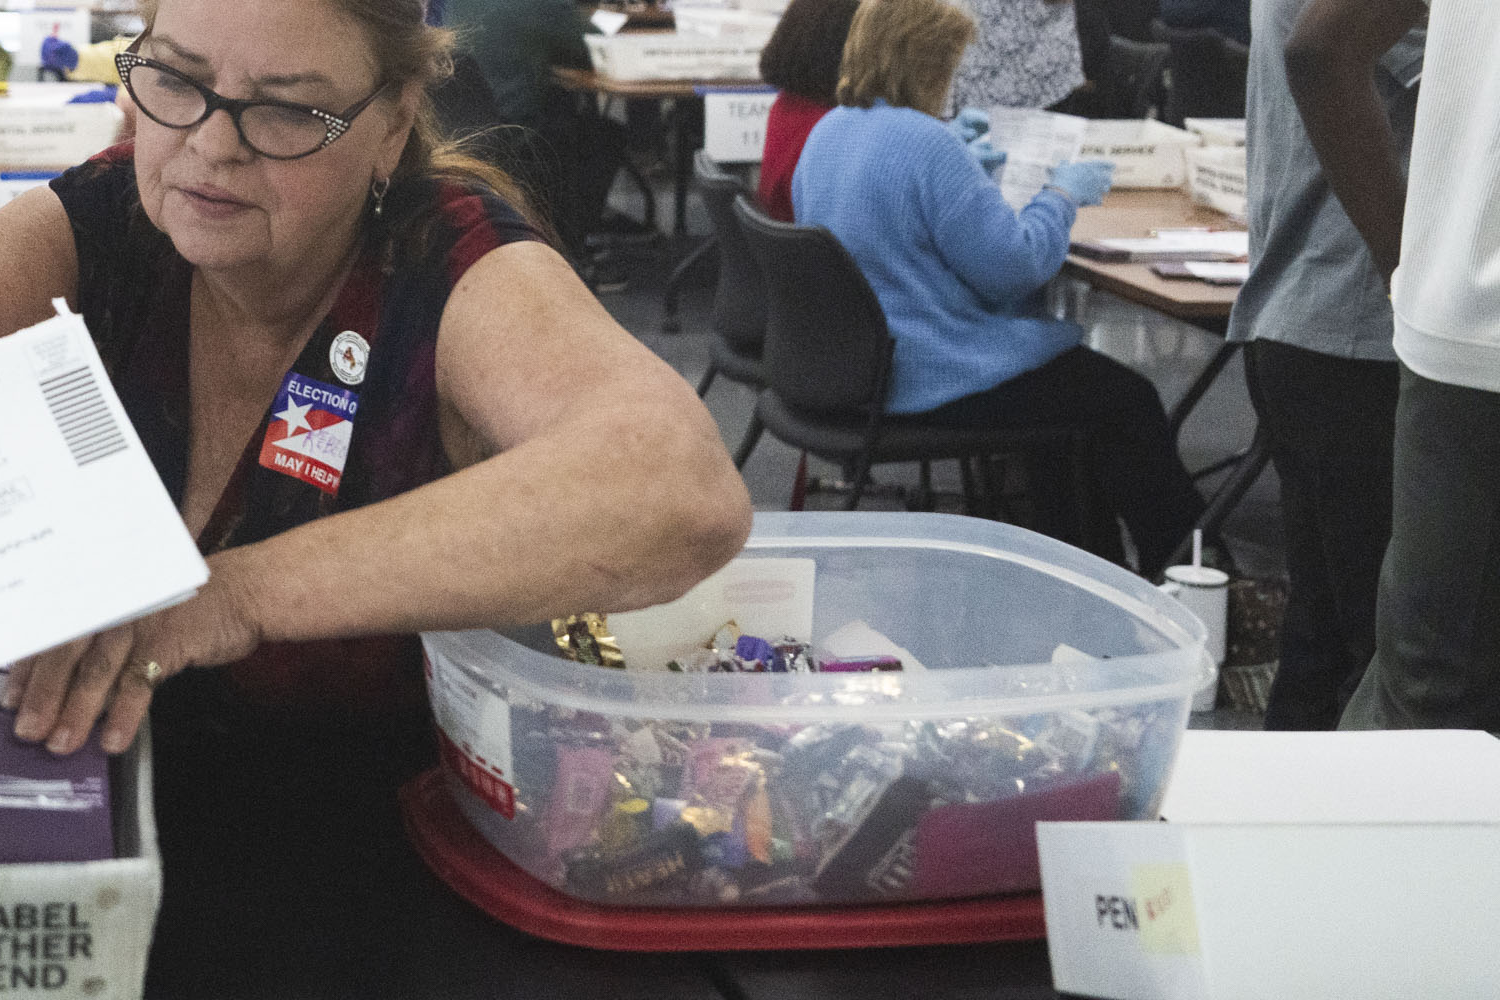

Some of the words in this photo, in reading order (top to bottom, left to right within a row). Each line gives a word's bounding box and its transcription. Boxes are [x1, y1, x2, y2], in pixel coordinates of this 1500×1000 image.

[288, 379, 349, 411] ELECTION
[274, 452, 304, 473] MAY
[304, 463, 311, 475] I
[1094, 893, 1140, 931] PEN
